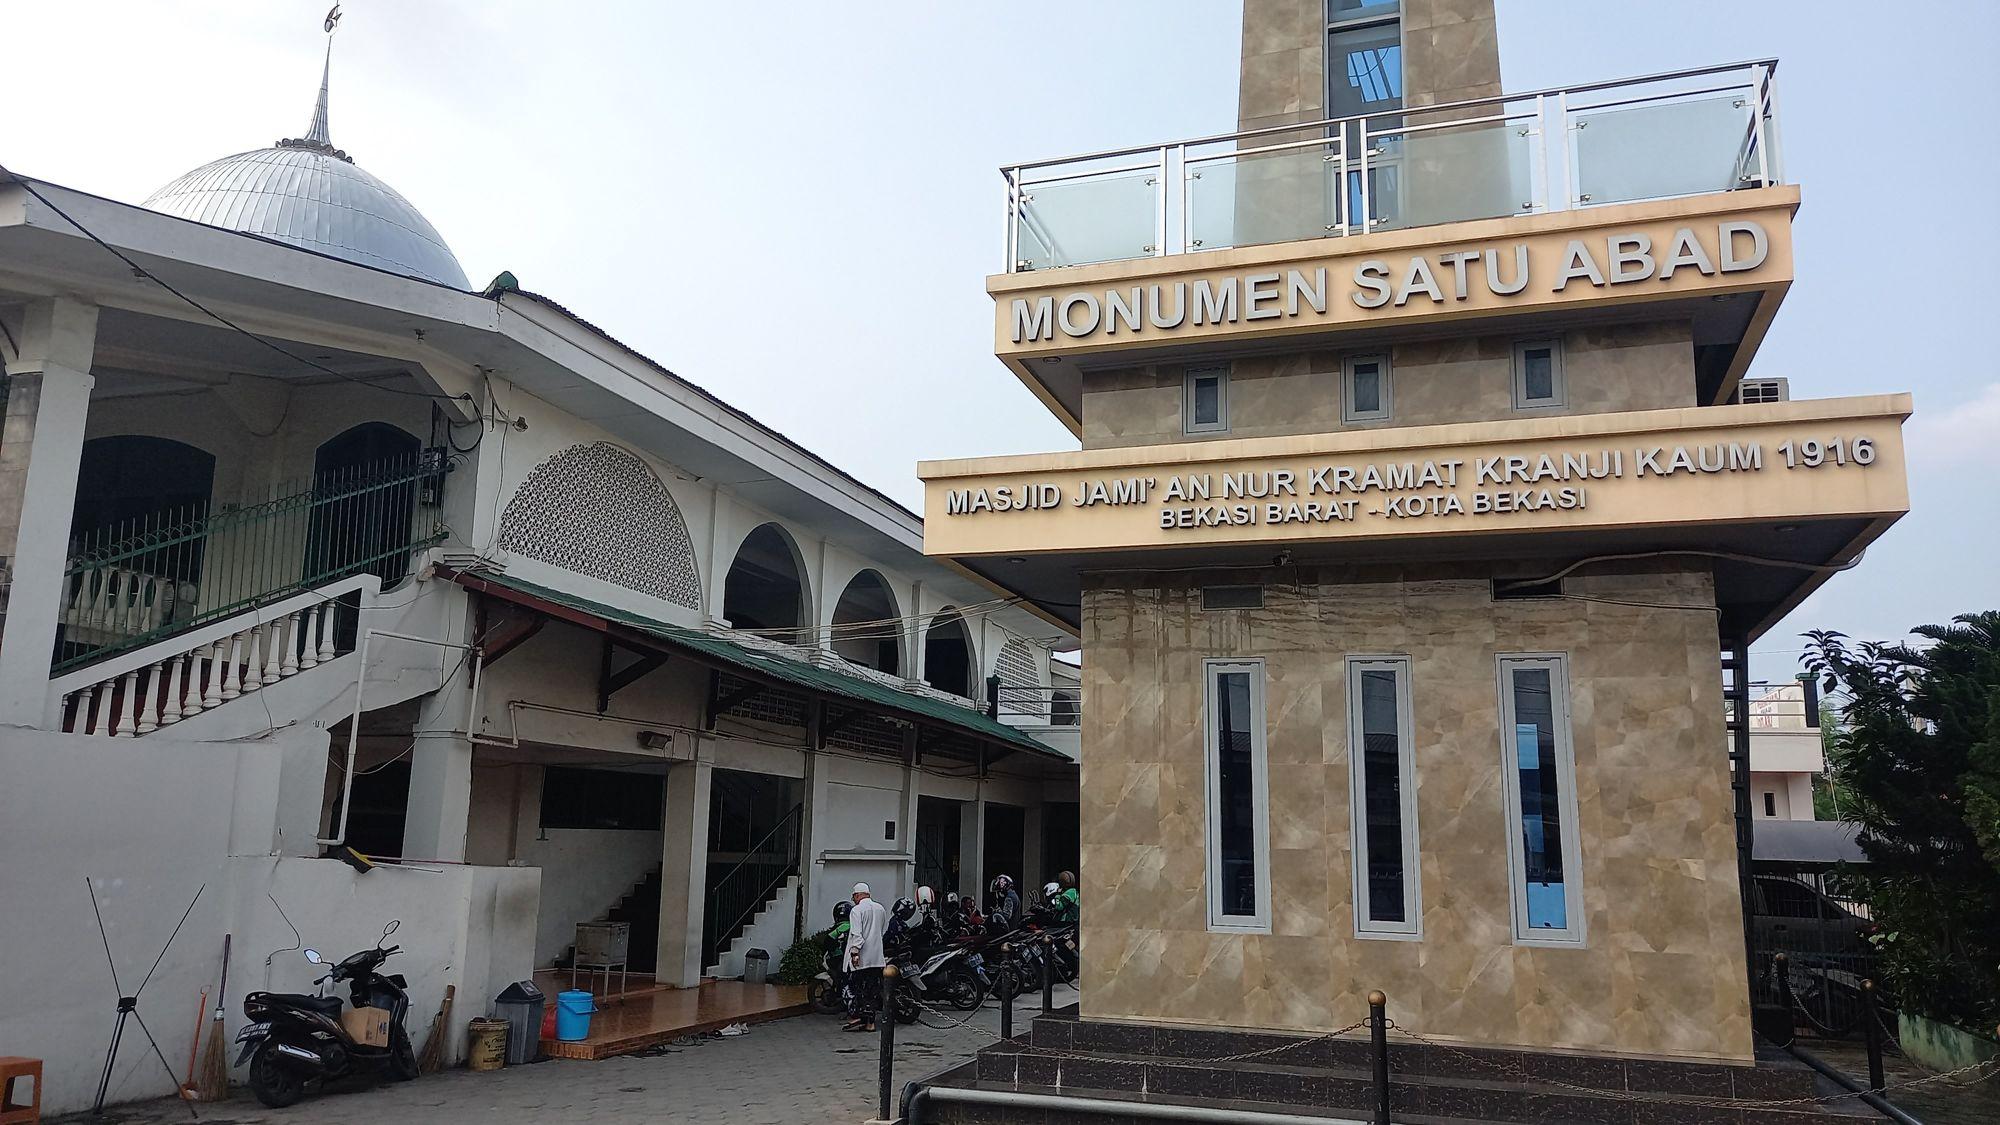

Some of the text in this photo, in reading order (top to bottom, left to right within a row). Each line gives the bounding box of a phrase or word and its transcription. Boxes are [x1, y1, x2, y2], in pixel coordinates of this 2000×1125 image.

[1012, 220, 1770, 343] MONUMEN SATU ABAD
[946, 482, 1061, 515] MASJID
[1162, 472, 1211, 502] AN
[1222, 469, 1297, 500] NUR
[1307, 460, 1464, 496] KRAMAT
[1475, 449, 1623, 486] KRANJI
[1634, 441, 1763, 479] KAUM
[1778, 435, 1876, 469] 1916
[1159, 503, 1257, 529] BEKASI
[1265, 499, 1360, 525] BARAT
[1384, 492, 1465, 519] KOTA
[1472, 487, 1586, 515] BEKASI
